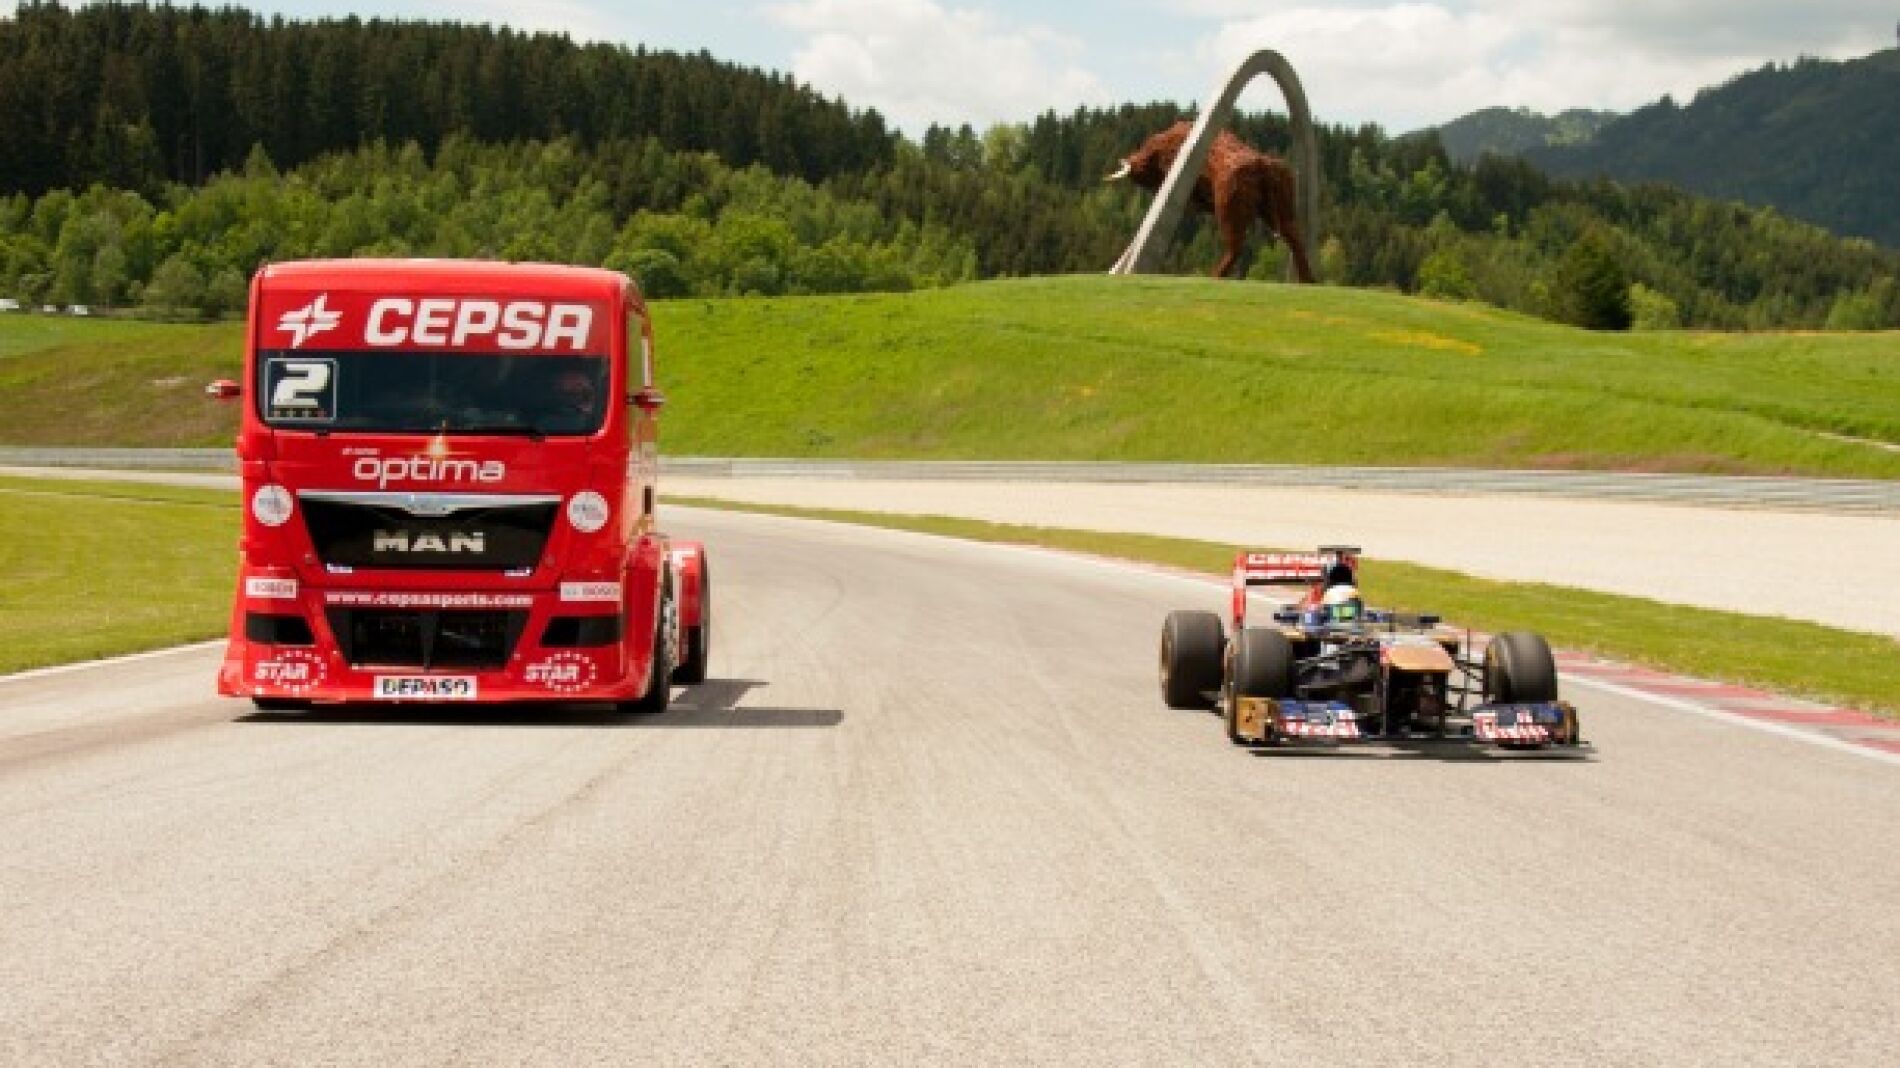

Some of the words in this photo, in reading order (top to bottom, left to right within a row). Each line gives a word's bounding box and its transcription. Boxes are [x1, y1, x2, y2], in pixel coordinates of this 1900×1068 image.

[364, 298, 593, 351] CEPSA
[271, 363, 331, 407] 2
[372, 529, 486, 553] MAN
[254, 660, 307, 681] STAR
[525, 664, 579, 683] STAR
